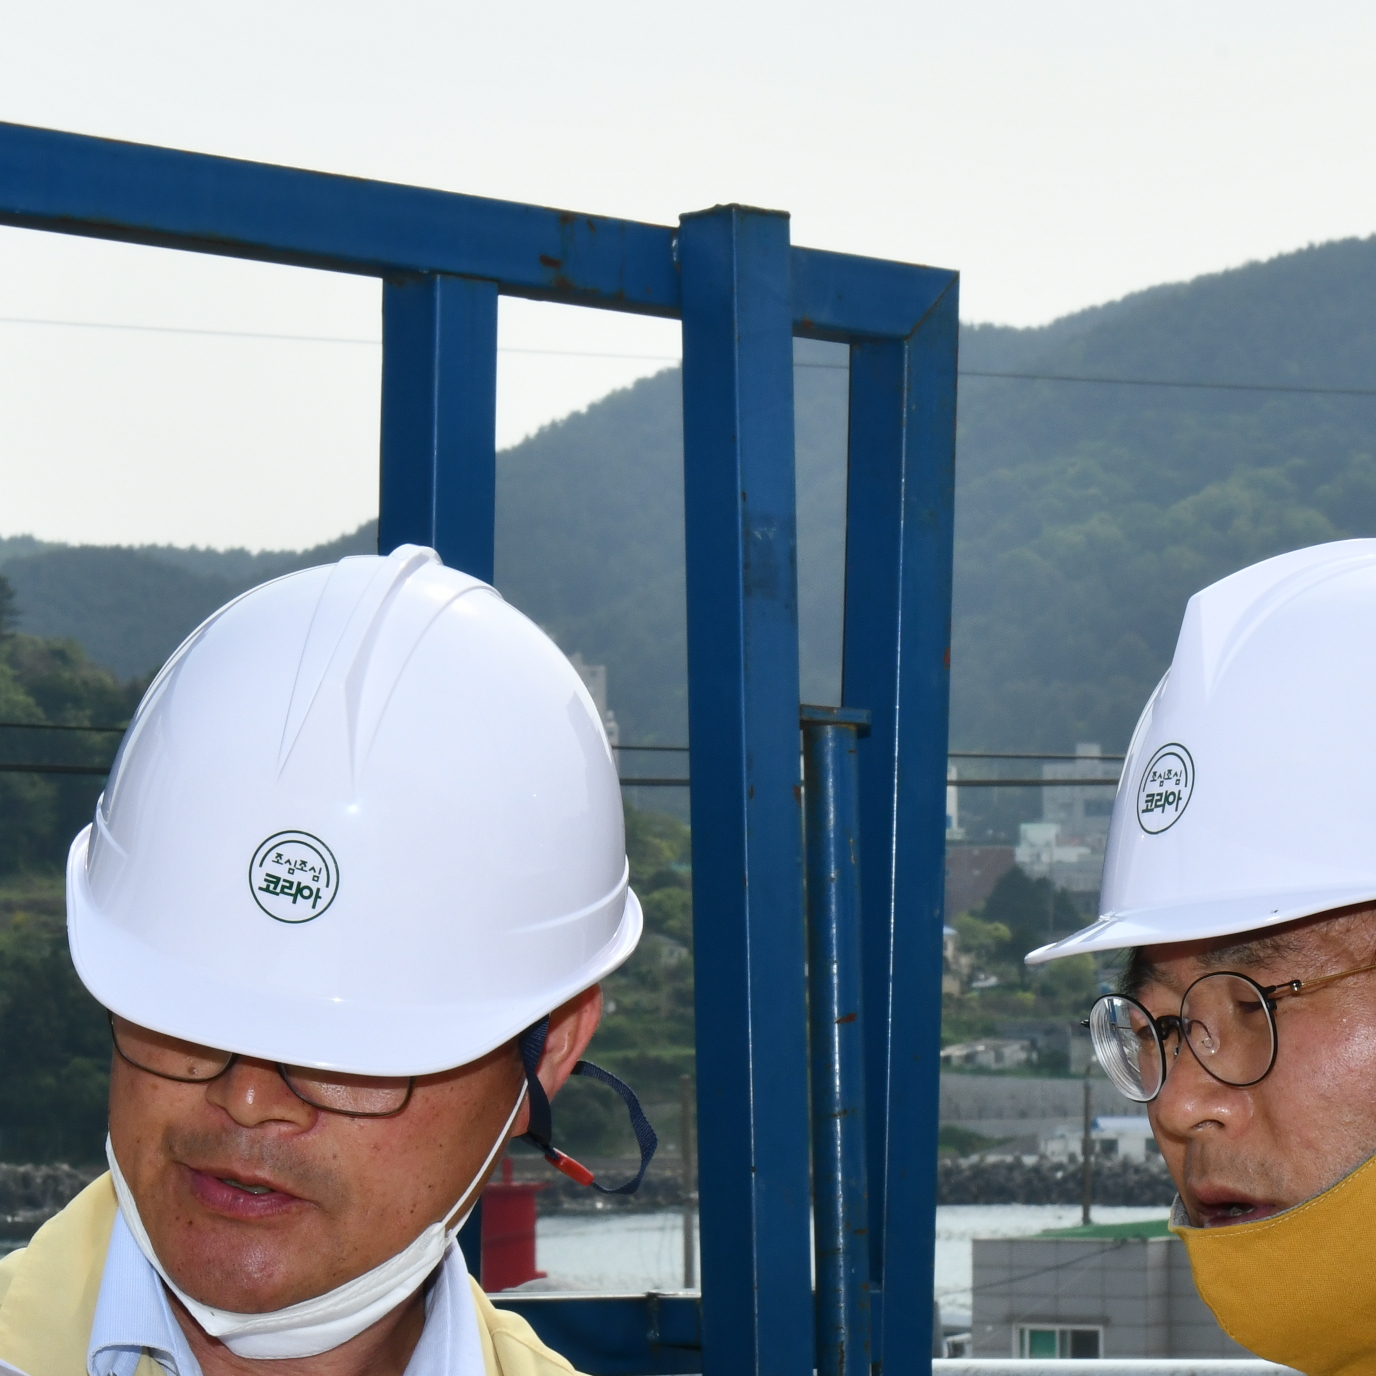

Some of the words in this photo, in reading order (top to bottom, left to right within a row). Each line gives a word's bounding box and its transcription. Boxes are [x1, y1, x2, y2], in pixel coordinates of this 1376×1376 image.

[1150, 769, 1182, 787] 조심조심
[1141, 790, 1182, 813] 코리아
[272, 852, 323, 883] 조심조심
[258, 872, 323, 909] 코리아
